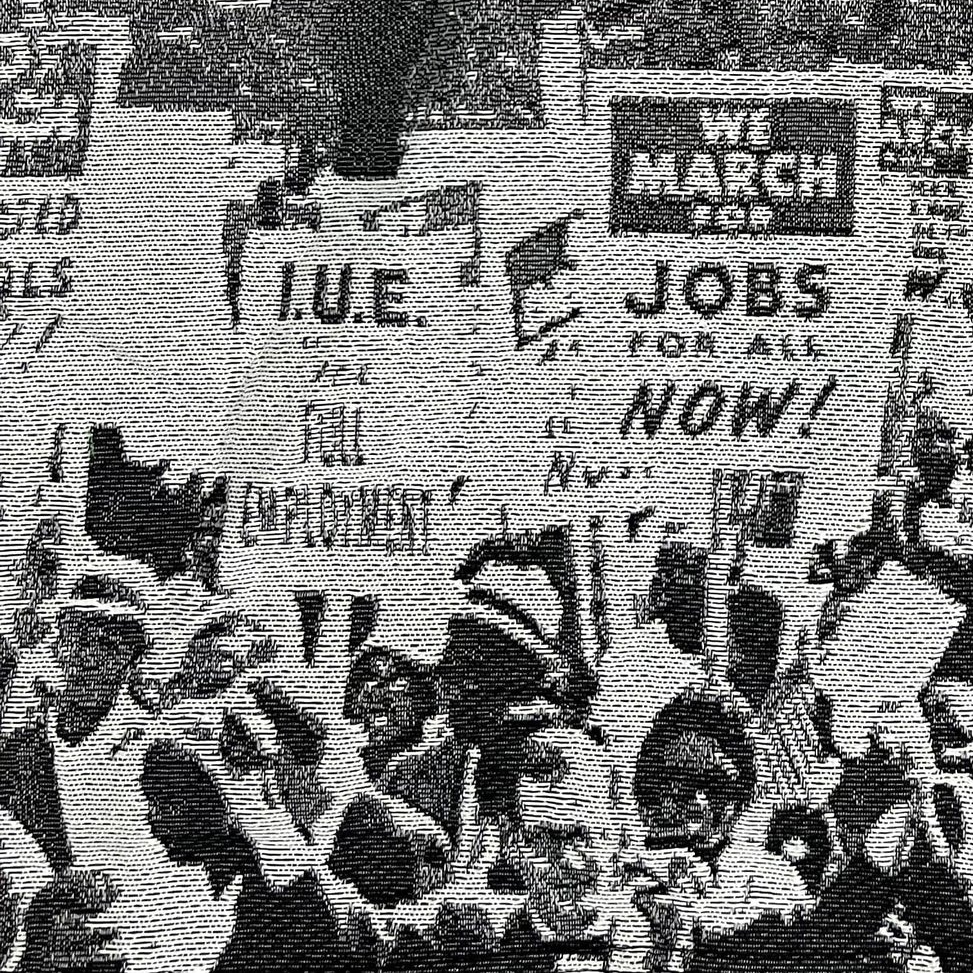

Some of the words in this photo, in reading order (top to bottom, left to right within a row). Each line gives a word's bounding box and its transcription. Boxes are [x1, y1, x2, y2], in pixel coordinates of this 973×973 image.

[702, 107, 772, 146] WE
[628, 151, 839, 199] MARCH
[694, 205, 774, 228] FOR
[278, 261, 429, 327] I.U.E.
[624, 261, 830, 319] JOBS
[619, 375, 838, 438] NOW!
